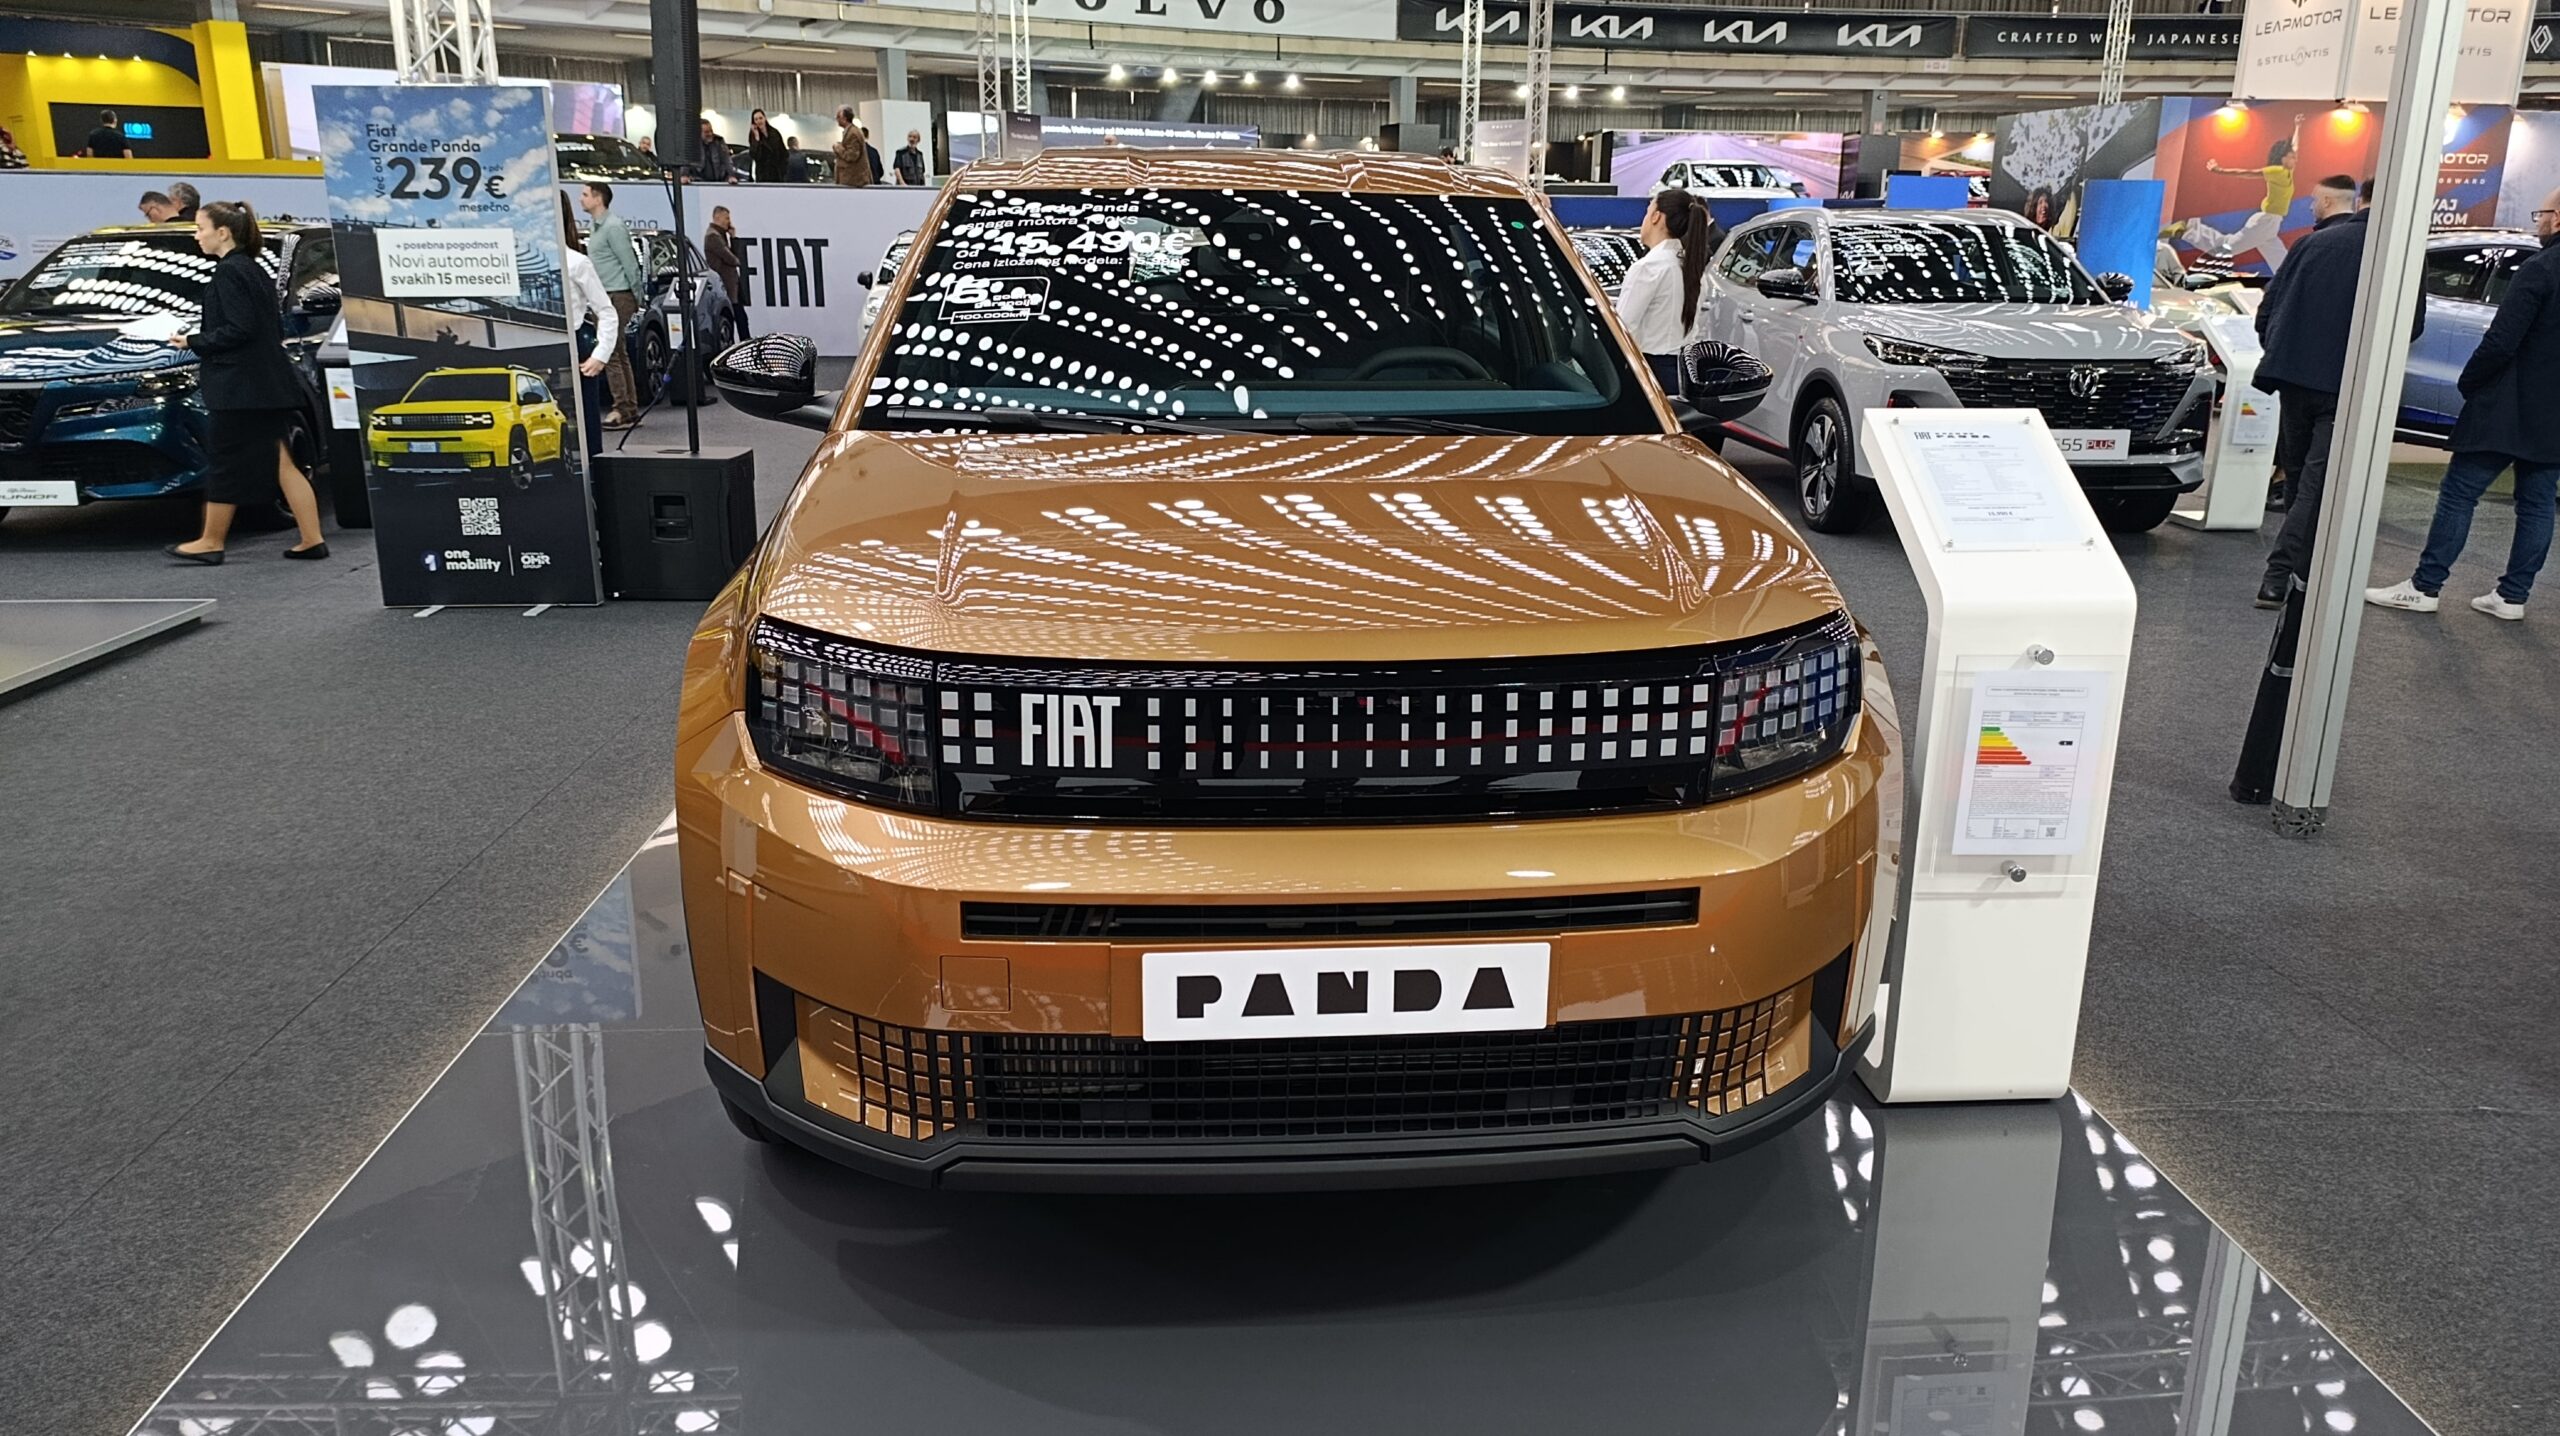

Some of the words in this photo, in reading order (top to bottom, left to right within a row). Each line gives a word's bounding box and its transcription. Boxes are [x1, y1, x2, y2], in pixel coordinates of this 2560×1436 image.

[1026, 0, 1285, 24] LVO
[1436, 8, 1520, 34] KA
[1571, 14, 1653, 40] KIA
[2255, 8, 2343, 36] LEAPMOTOR
[1704, 19, 1787, 45] KIA
[1837, 23, 1922, 48] KIA
[1997, 31, 2078, 44] CRAFTED
[2090, 33, 2136, 45] WH
[2147, 33, 2240, 45] JAPANESE
[2265, 47, 2329, 65] STELLANTIS
[365, 123, 397, 137] Fiat
[368, 139, 428, 152] Grande
[431, 139, 481, 152] Panda
[370, 156, 383, 173] od
[459, 202, 511, 212] mesečno
[1081, 202, 1139, 213] Panda
[1018, 217, 1078, 226] motora
[1084, 215, 1138, 225] 10KS
[404, 242, 445, 250] posebna
[446, 241, 499, 251] pogodnost
[956, 248, 979, 258] Od
[388, 254, 425, 268] Novi
[428, 253, 510, 268] automobil
[953, 261, 990, 270] Cena
[994, 256, 1061, 268] izložeog
[391, 273, 435, 285] svakih
[438, 272, 453, 285] 15
[455, 272, 511, 285] meseci!
[731, 237, 829, 307] FIAT
[2086, 440, 2115, 449] PLUS
[444, 550, 470, 559] one
[521, 555, 551, 565] OMR
[446, 558, 501, 572] mobility
[2391, 593, 2421, 603] JEANS
[1021, 693, 1120, 768] FIAT
[1176, 966, 1515, 1018] PANDA
